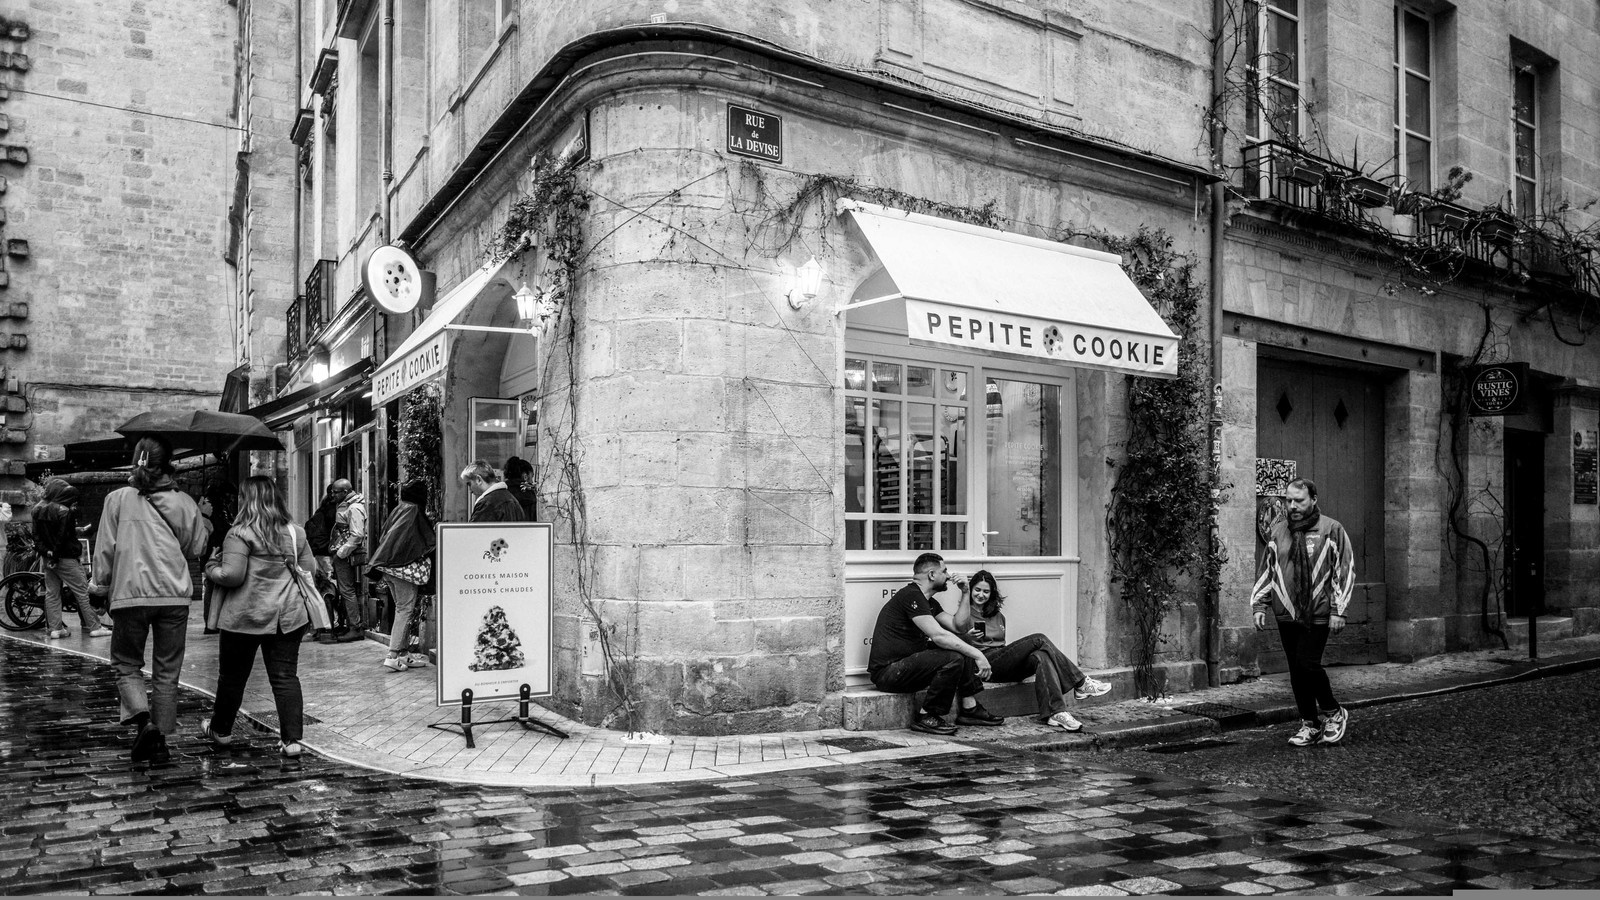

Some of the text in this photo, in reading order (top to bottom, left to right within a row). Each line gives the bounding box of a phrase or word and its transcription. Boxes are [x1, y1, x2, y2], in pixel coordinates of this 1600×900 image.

[745, 113, 765, 129] RUE
[751, 130, 760, 139] de
[730, 135, 779, 157] LA DEVISE
[927, 312, 1165, 366] PEPITE COOKIE
[377, 344, 440, 397] PEPITE COOKIE
[1477, 380, 1513, 391] RUSTIC
[1480, 388, 1510, 397] VINES
